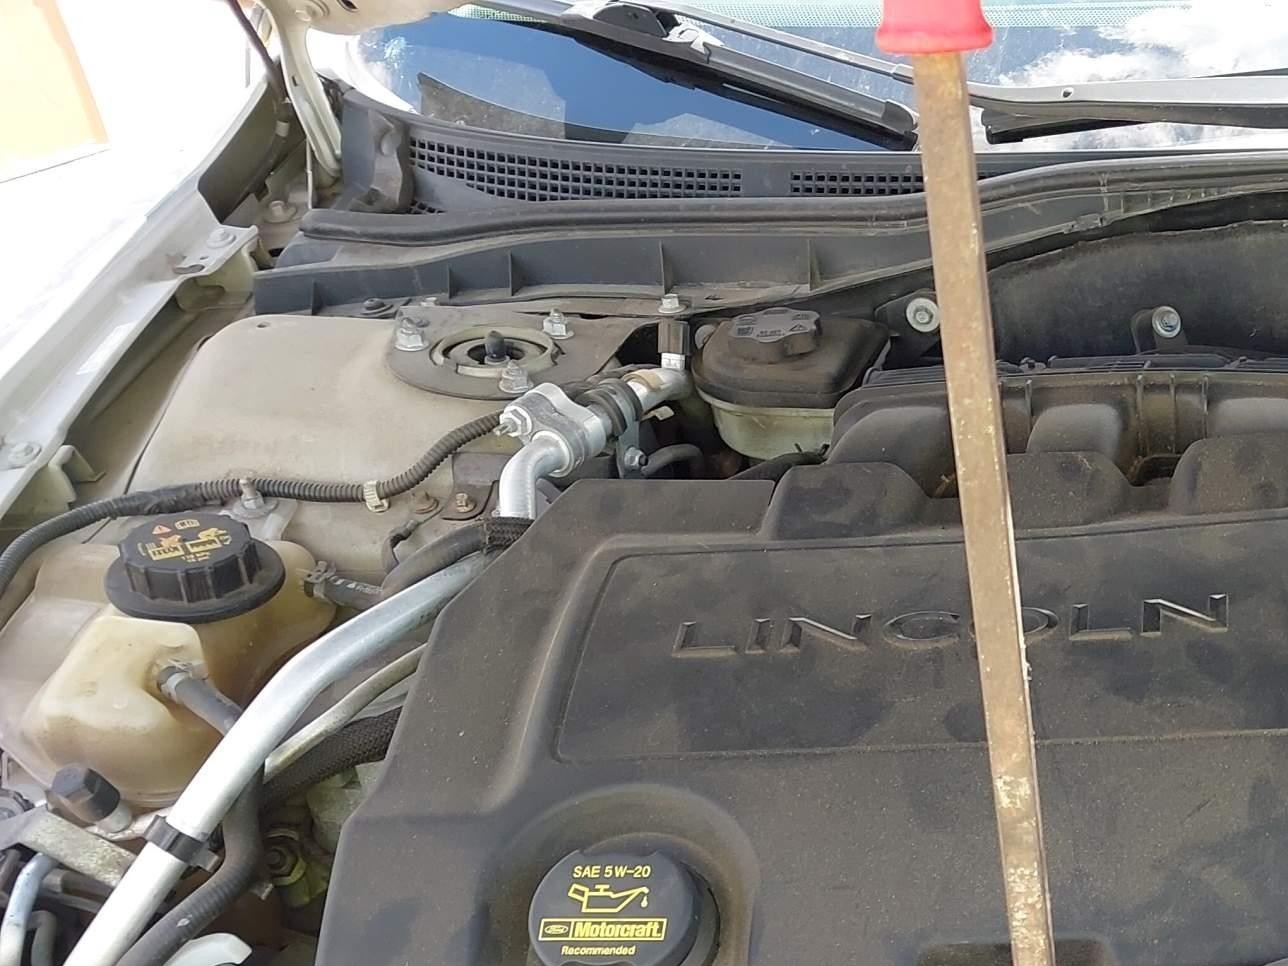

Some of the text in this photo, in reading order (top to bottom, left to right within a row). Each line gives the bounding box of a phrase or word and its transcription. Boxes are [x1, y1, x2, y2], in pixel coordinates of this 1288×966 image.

[572, 865, 651, 878] SAE 5W-20
[561, 945, 636, 956] Recommended
